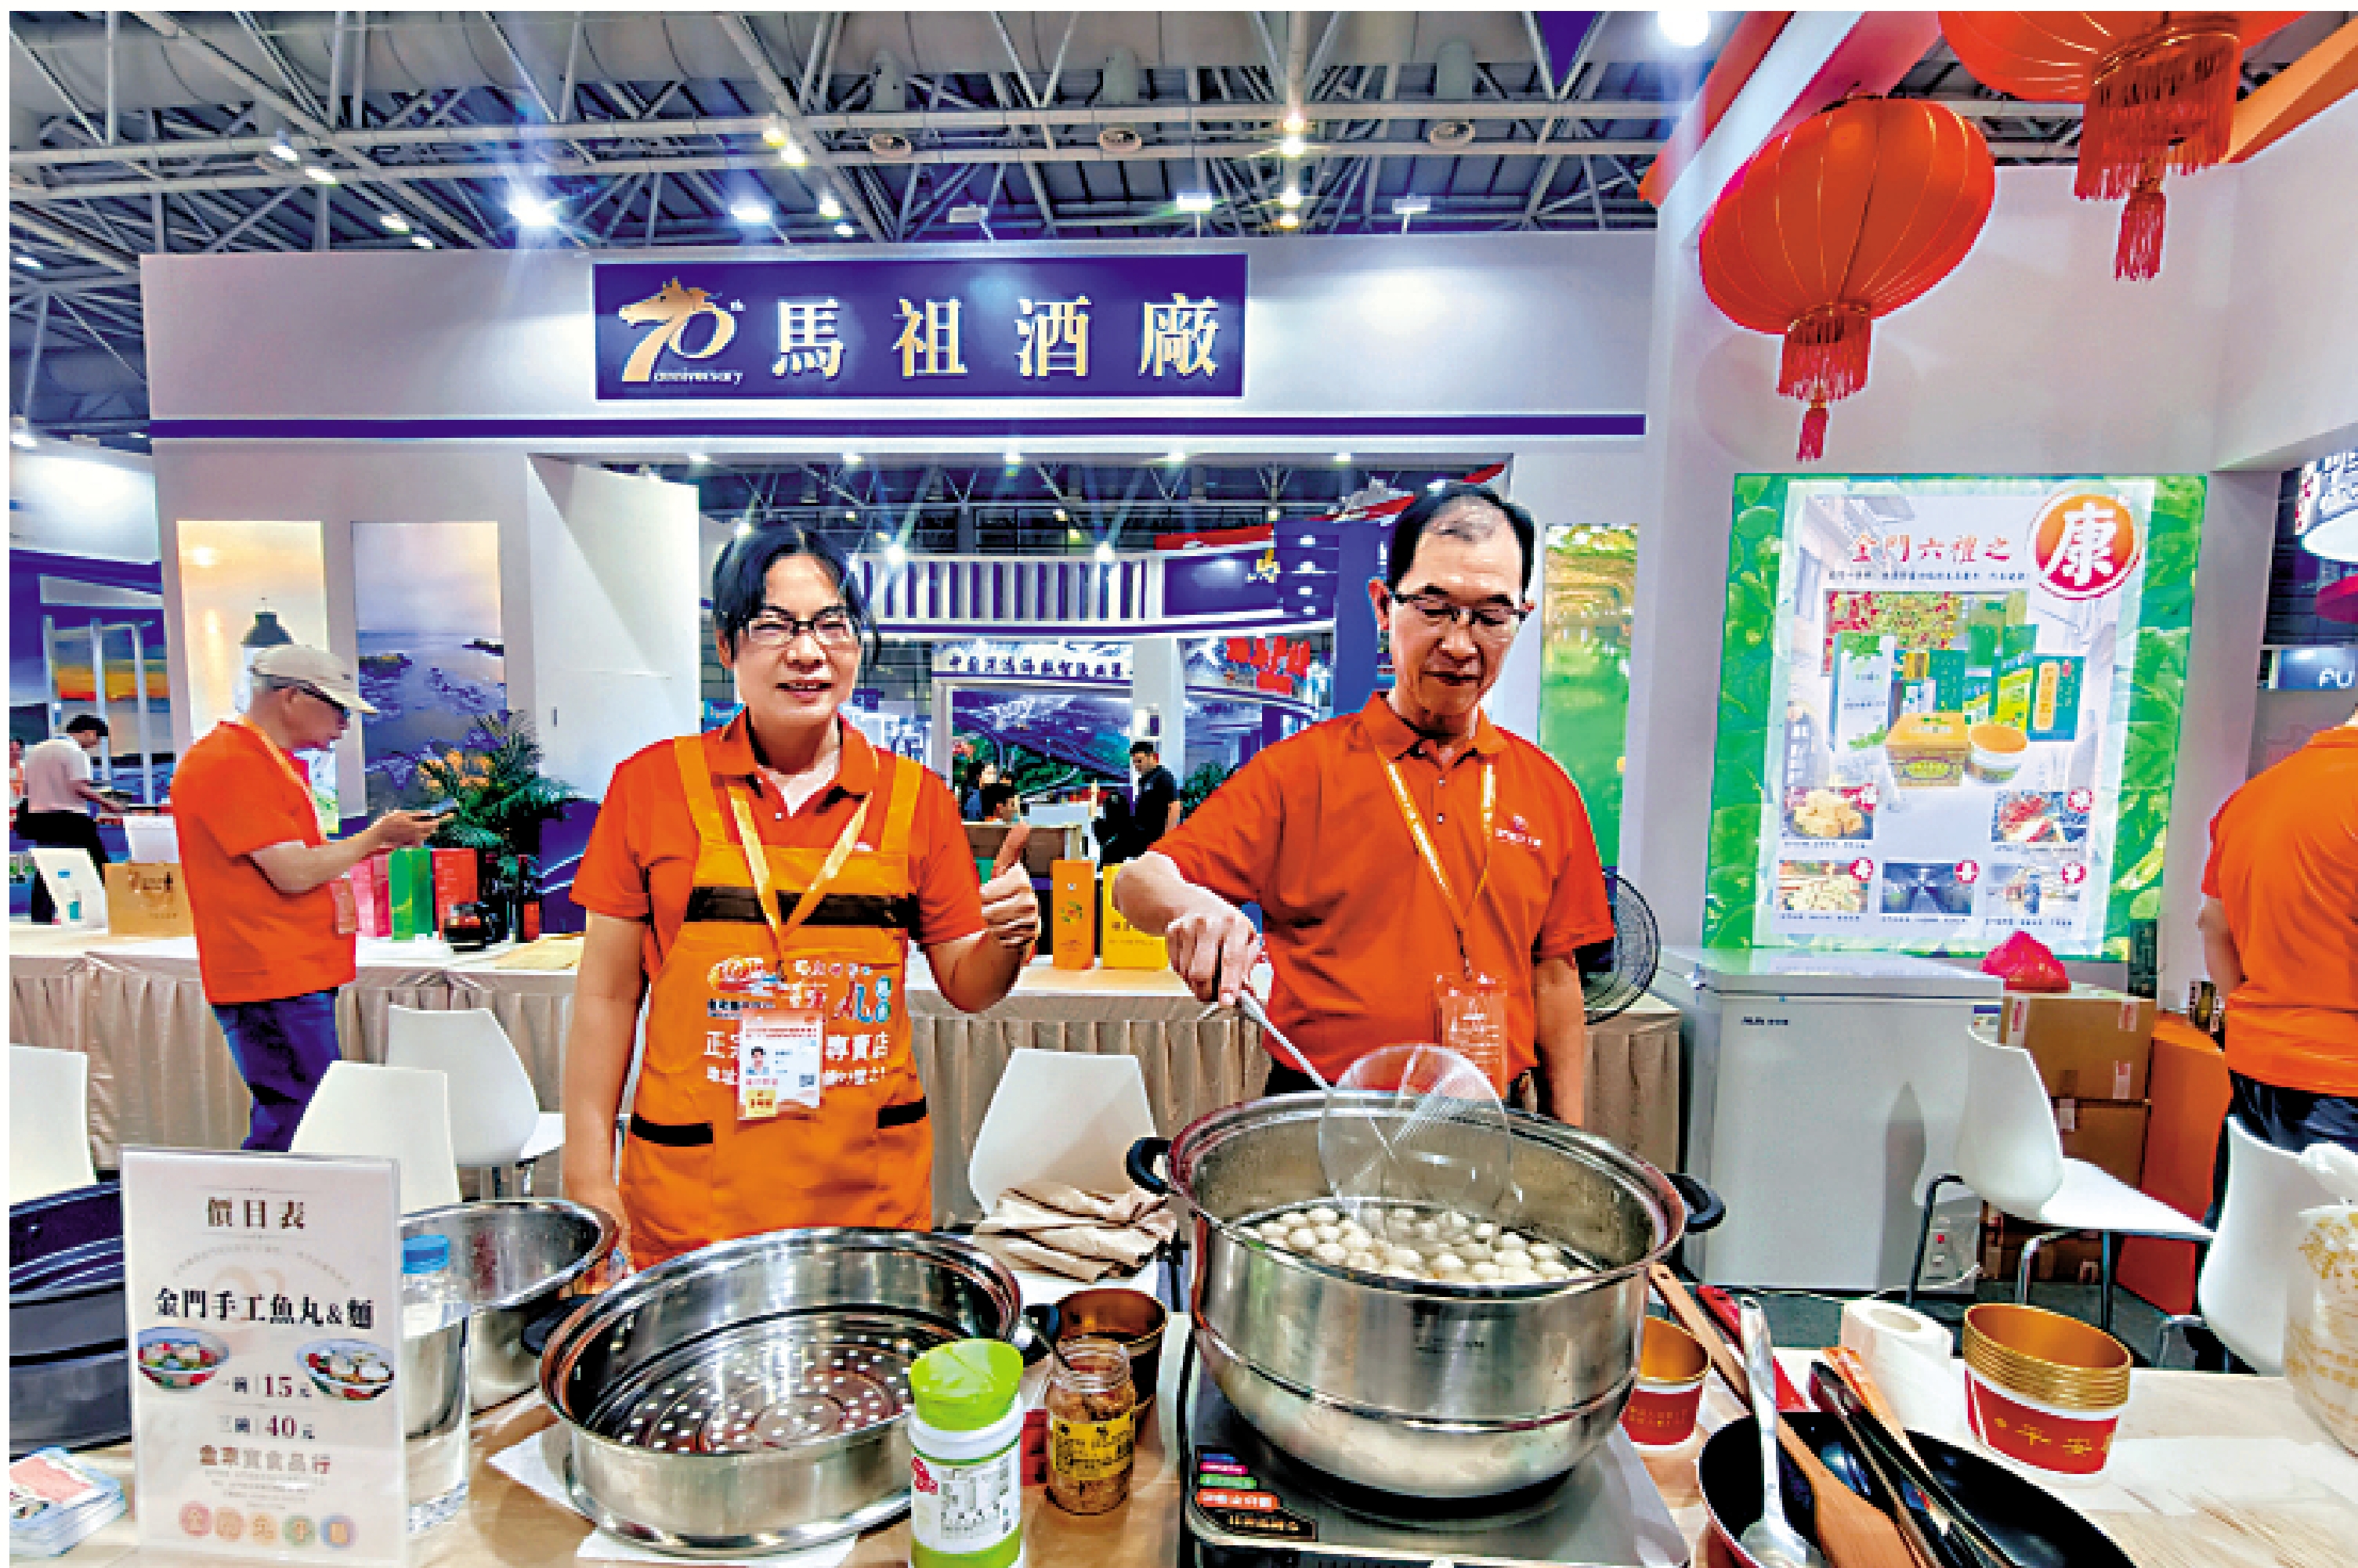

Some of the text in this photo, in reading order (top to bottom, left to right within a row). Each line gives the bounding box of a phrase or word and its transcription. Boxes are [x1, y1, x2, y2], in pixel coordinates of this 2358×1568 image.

[772, 293, 1220, 378] 馬祖酒廠
[1852, 533, 2012, 564] 金門六禮之
[2048, 502, 2117, 587] 康
[207, 1196, 306, 1230] 價目表
[154, 1287, 374, 1330] 金門手工魚丸&麵
